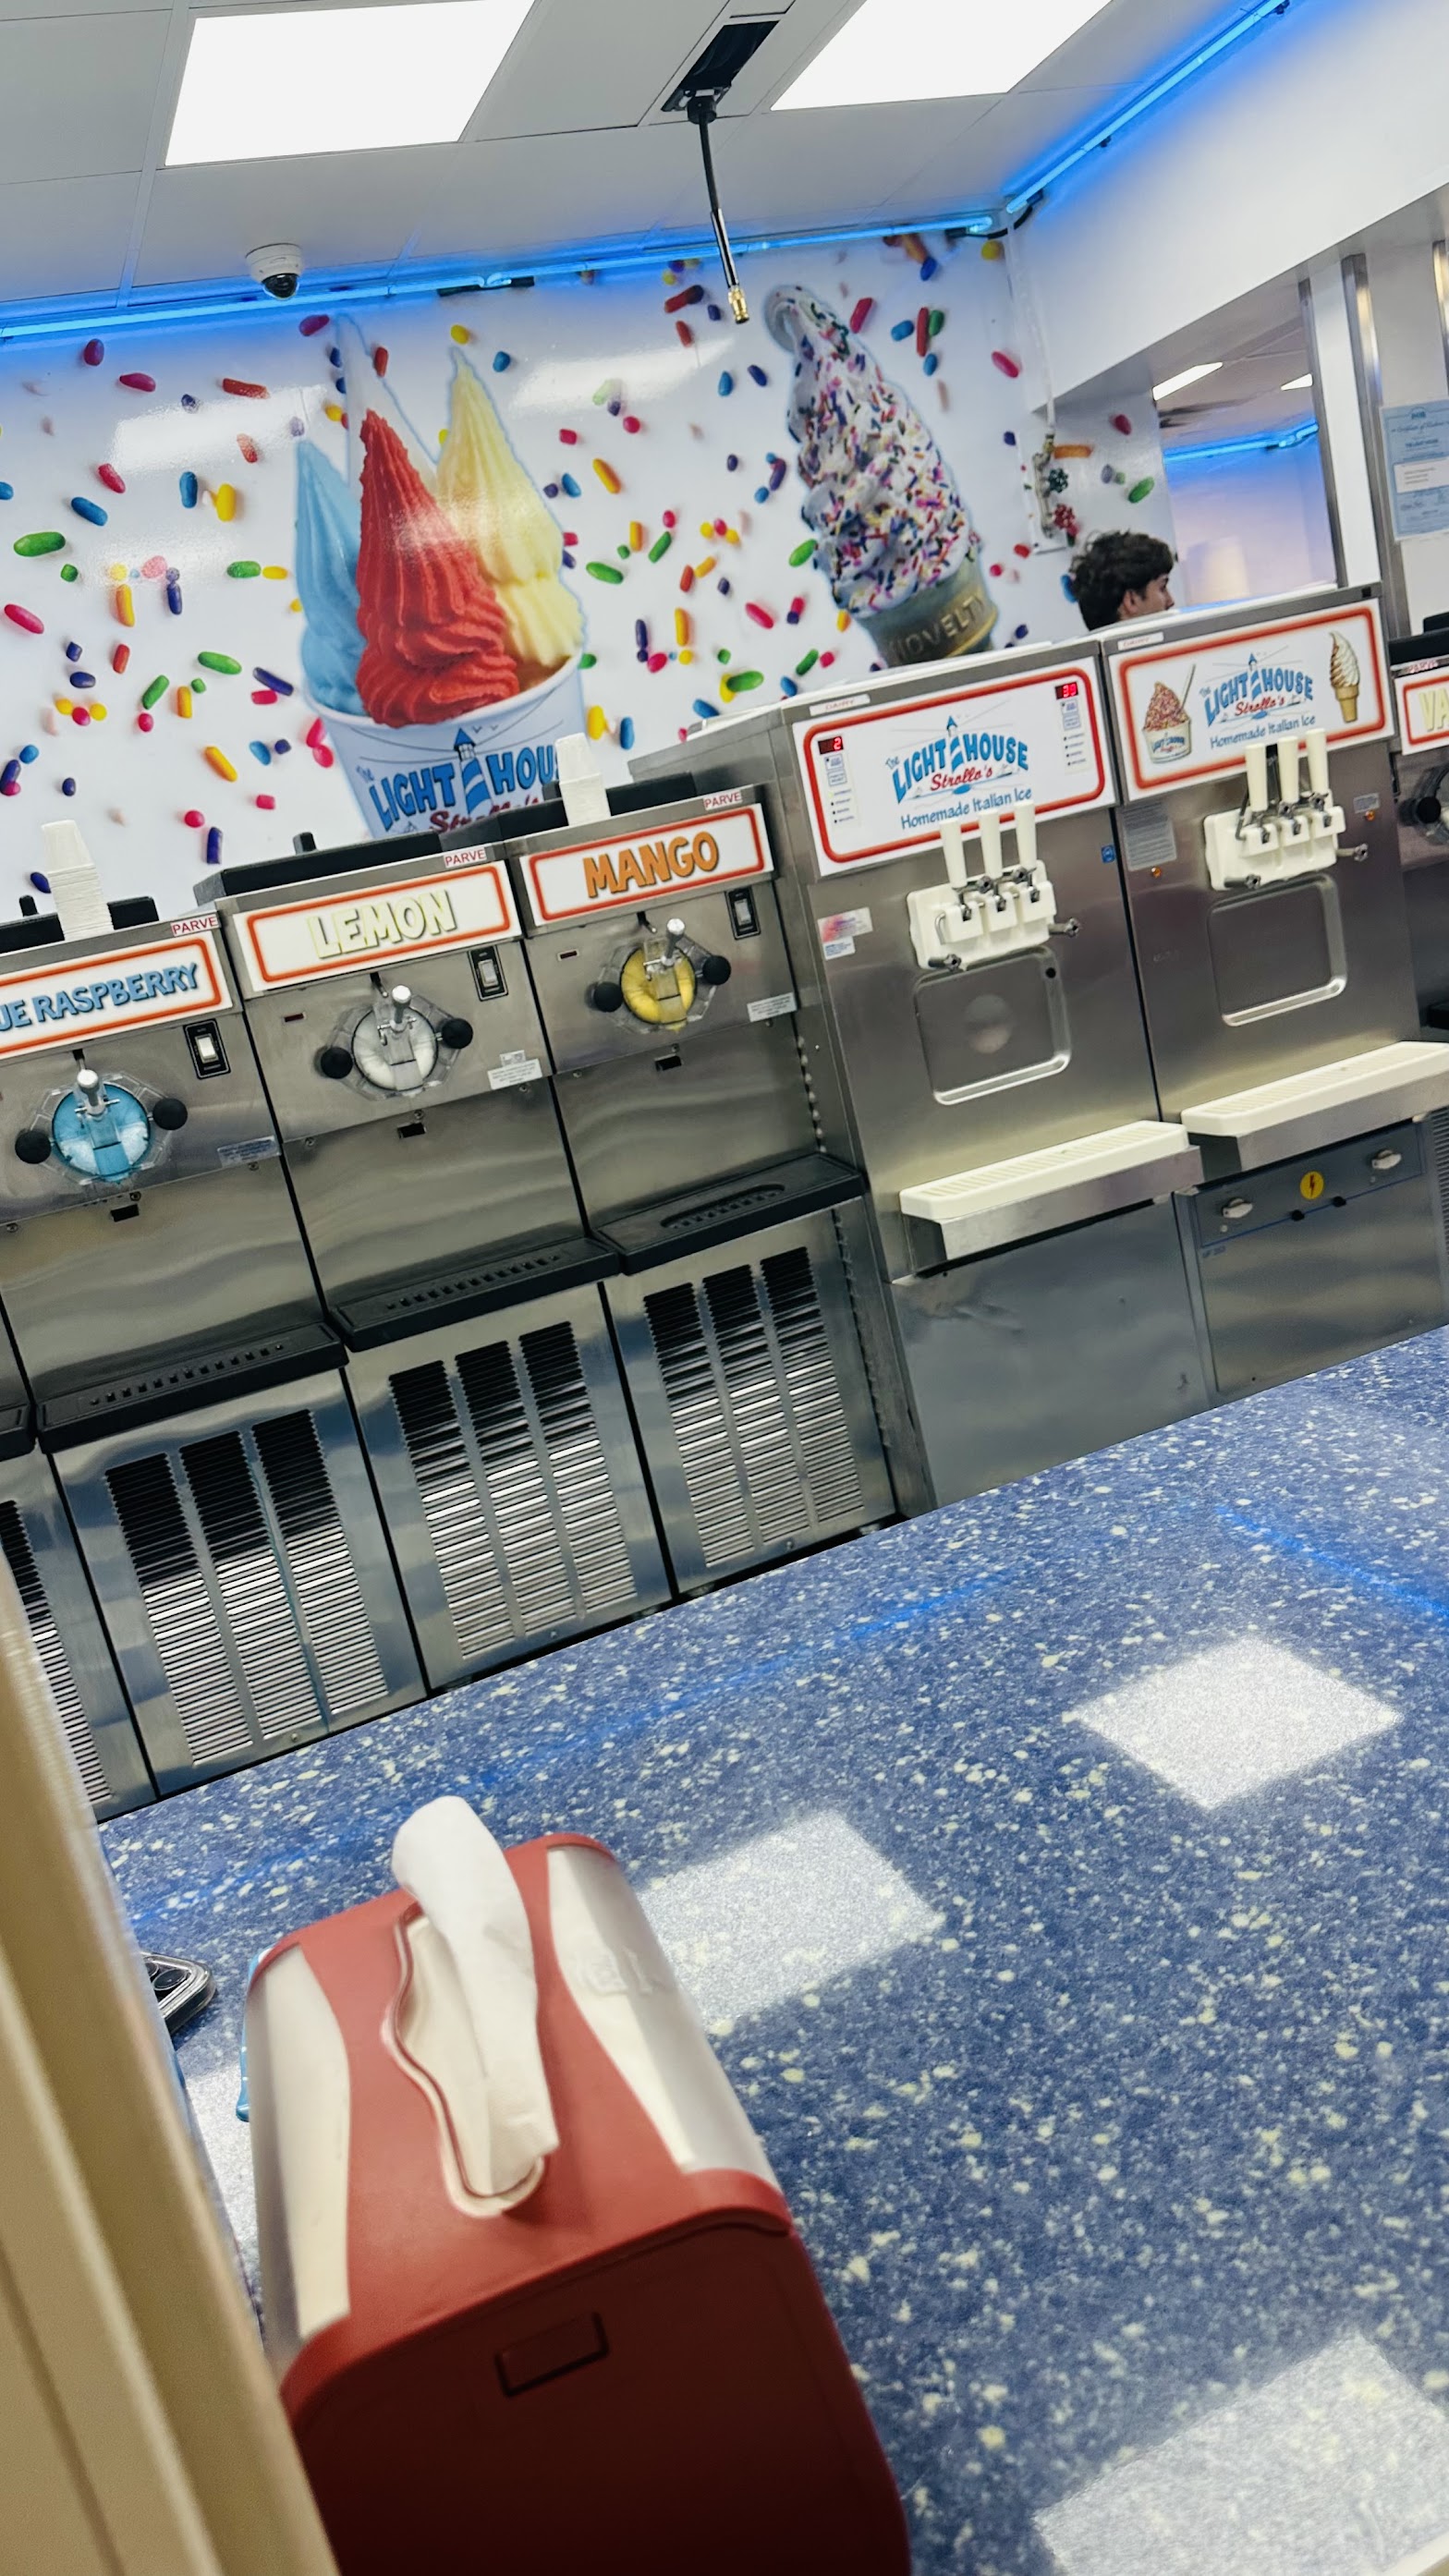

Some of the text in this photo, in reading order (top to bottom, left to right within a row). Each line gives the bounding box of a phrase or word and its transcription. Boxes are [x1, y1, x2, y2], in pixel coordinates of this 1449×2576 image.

[1204, 672, 1248, 727] LIGHT
[1260, 667, 1313, 700] HOUSE
[962, 733, 1029, 771] HOUSE
[1210, 715, 1315, 749] Homemade Italian Ice
[885, 756, 900, 770] The
[892, 737, 946, 804] LIGHT
[931, 764, 992, 791] Strollo's
[370, 762, 456, 832] LIGHT
[485, 745, 558, 796] HOU
[704, 792, 740, 809] PARVE
[901, 787, 1032, 830] Homemade Italian Ice
[445, 849, 485, 867] PARVE
[583, 832, 719, 898] MANGO
[173, 916, 217, 936] PARVE
[307, 890, 457, 959] LEMON
[31, 962, 199, 1023] RASPBERRY
